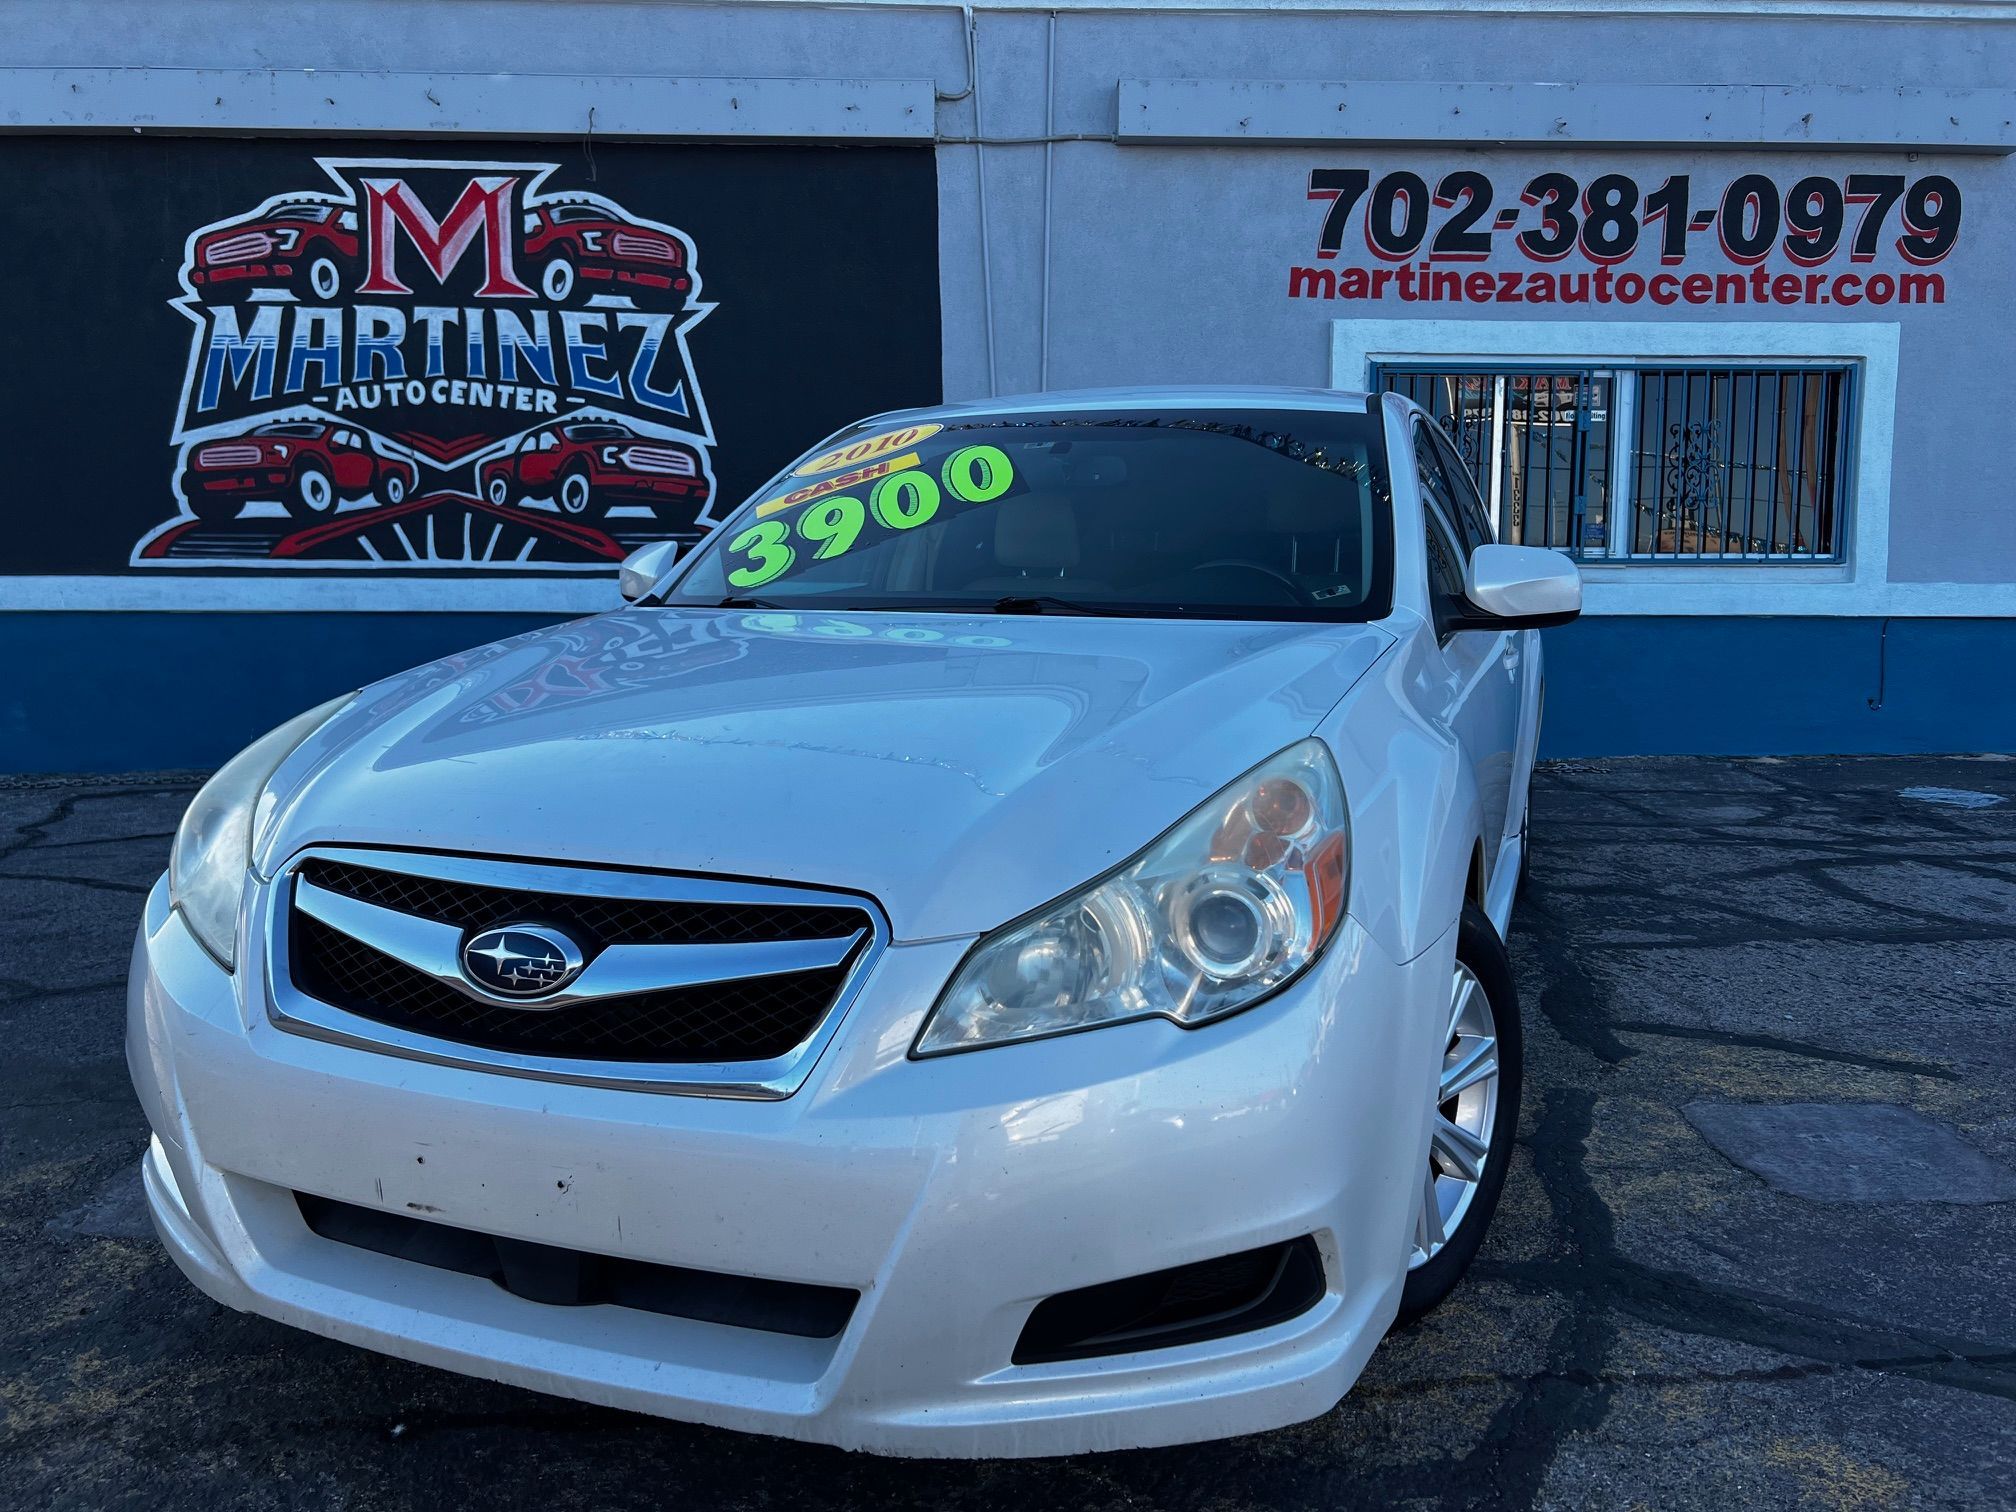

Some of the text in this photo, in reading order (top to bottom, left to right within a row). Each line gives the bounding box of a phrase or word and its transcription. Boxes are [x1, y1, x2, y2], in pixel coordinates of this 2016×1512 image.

[356, 177, 539, 298] M
[1307, 169, 1962, 268] 702-381-0979
[1288, 262, 1947, 305] martinezautocenter.com
[198, 305, 689, 418] MARTINEZ
[783, 462, 890, 505] CASH
[815, 429, 919, 472] 2010
[728, 445, 1014, 587] 3900
